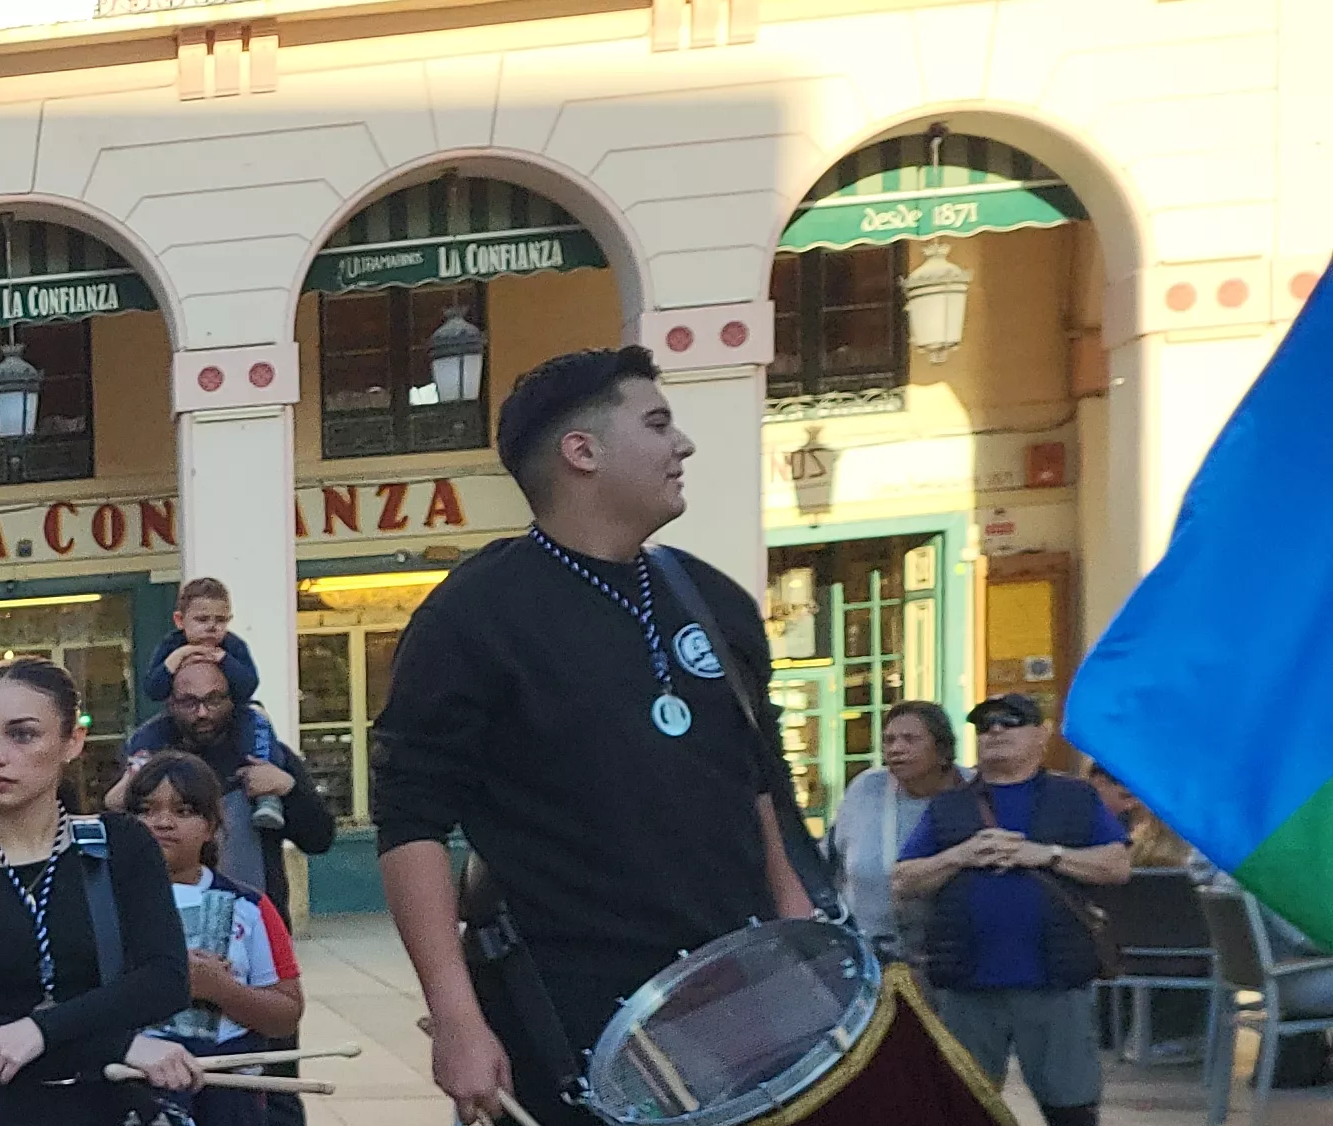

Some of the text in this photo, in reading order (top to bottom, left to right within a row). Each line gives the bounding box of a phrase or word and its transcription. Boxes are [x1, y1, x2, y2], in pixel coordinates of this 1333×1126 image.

[860, 202, 979, 232] desde 1871
[438, 246, 462, 278] LA
[465, 239, 565, 275] CONFIANZA
[2, 287, 24, 319] LA
[28, 282, 120, 316] CONFIANZA
